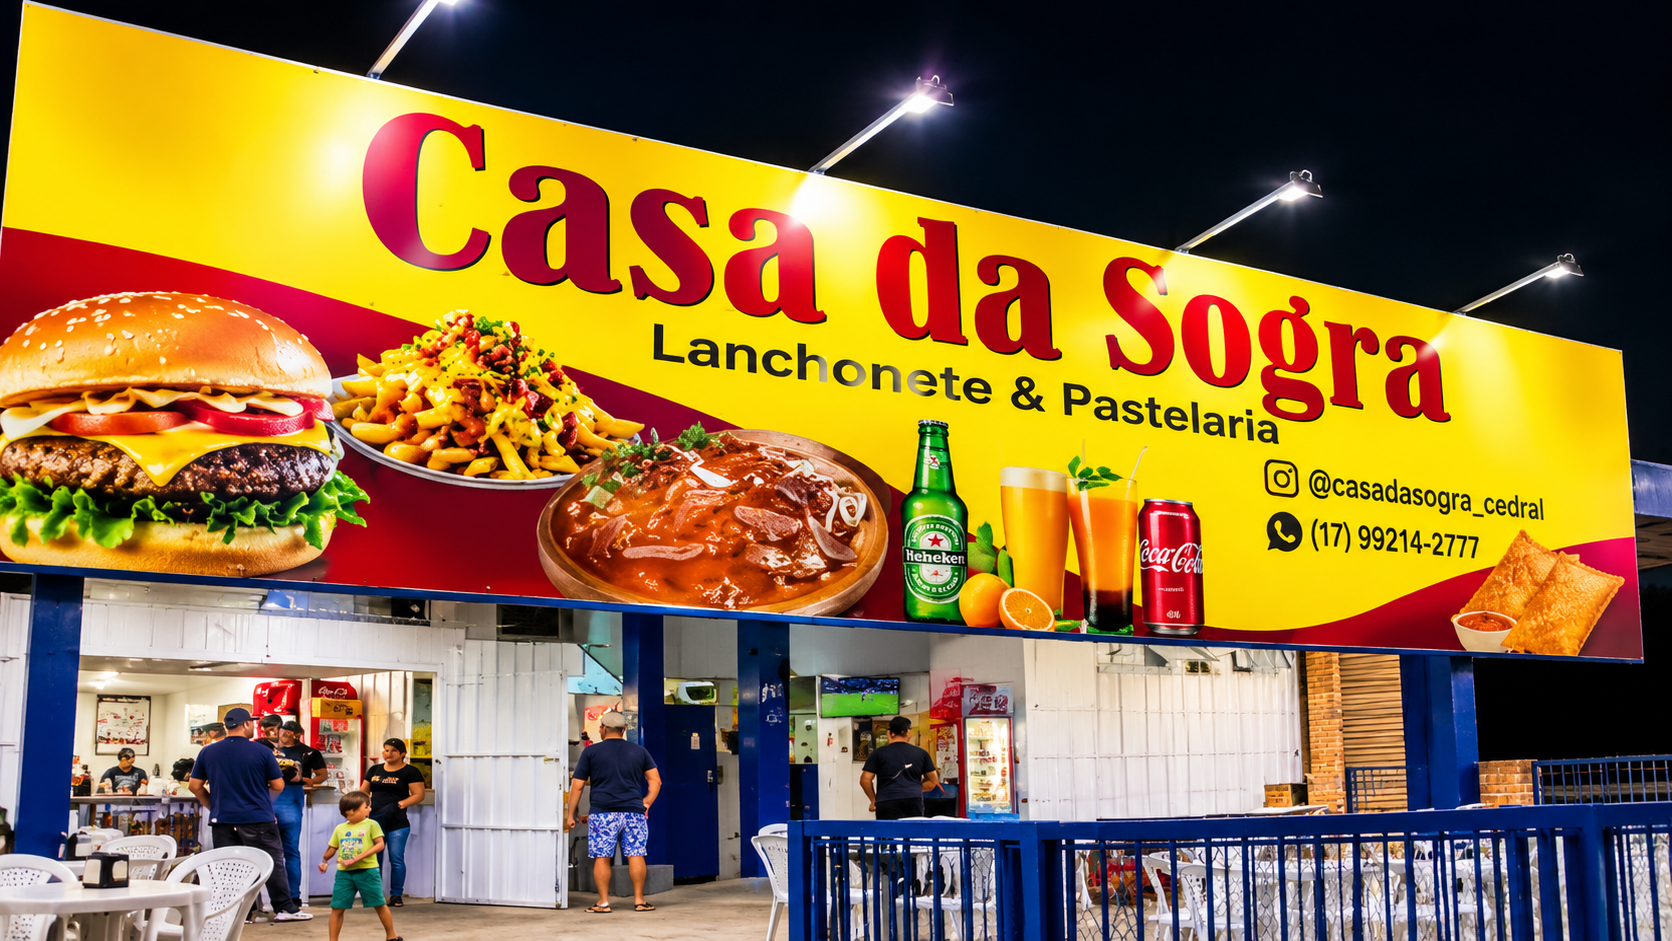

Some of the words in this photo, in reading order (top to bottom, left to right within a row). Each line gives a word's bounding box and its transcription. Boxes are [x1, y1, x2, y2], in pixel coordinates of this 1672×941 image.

[363, 113, 827, 325] Casa
[876, 217, 1062, 362] da
[1102, 256, 1451, 423] Sogra
[654, 324, 992, 405] Lanchonete
[1011, 376, 1045, 412] &
[1063, 383, 1279, 444] Pastelaria
[1309, 469, 1544, 521] @casadasogra_cedral
[1311, 518, 1351, 553] (17)
[1358, 525, 1479, 559] 99214-2777
